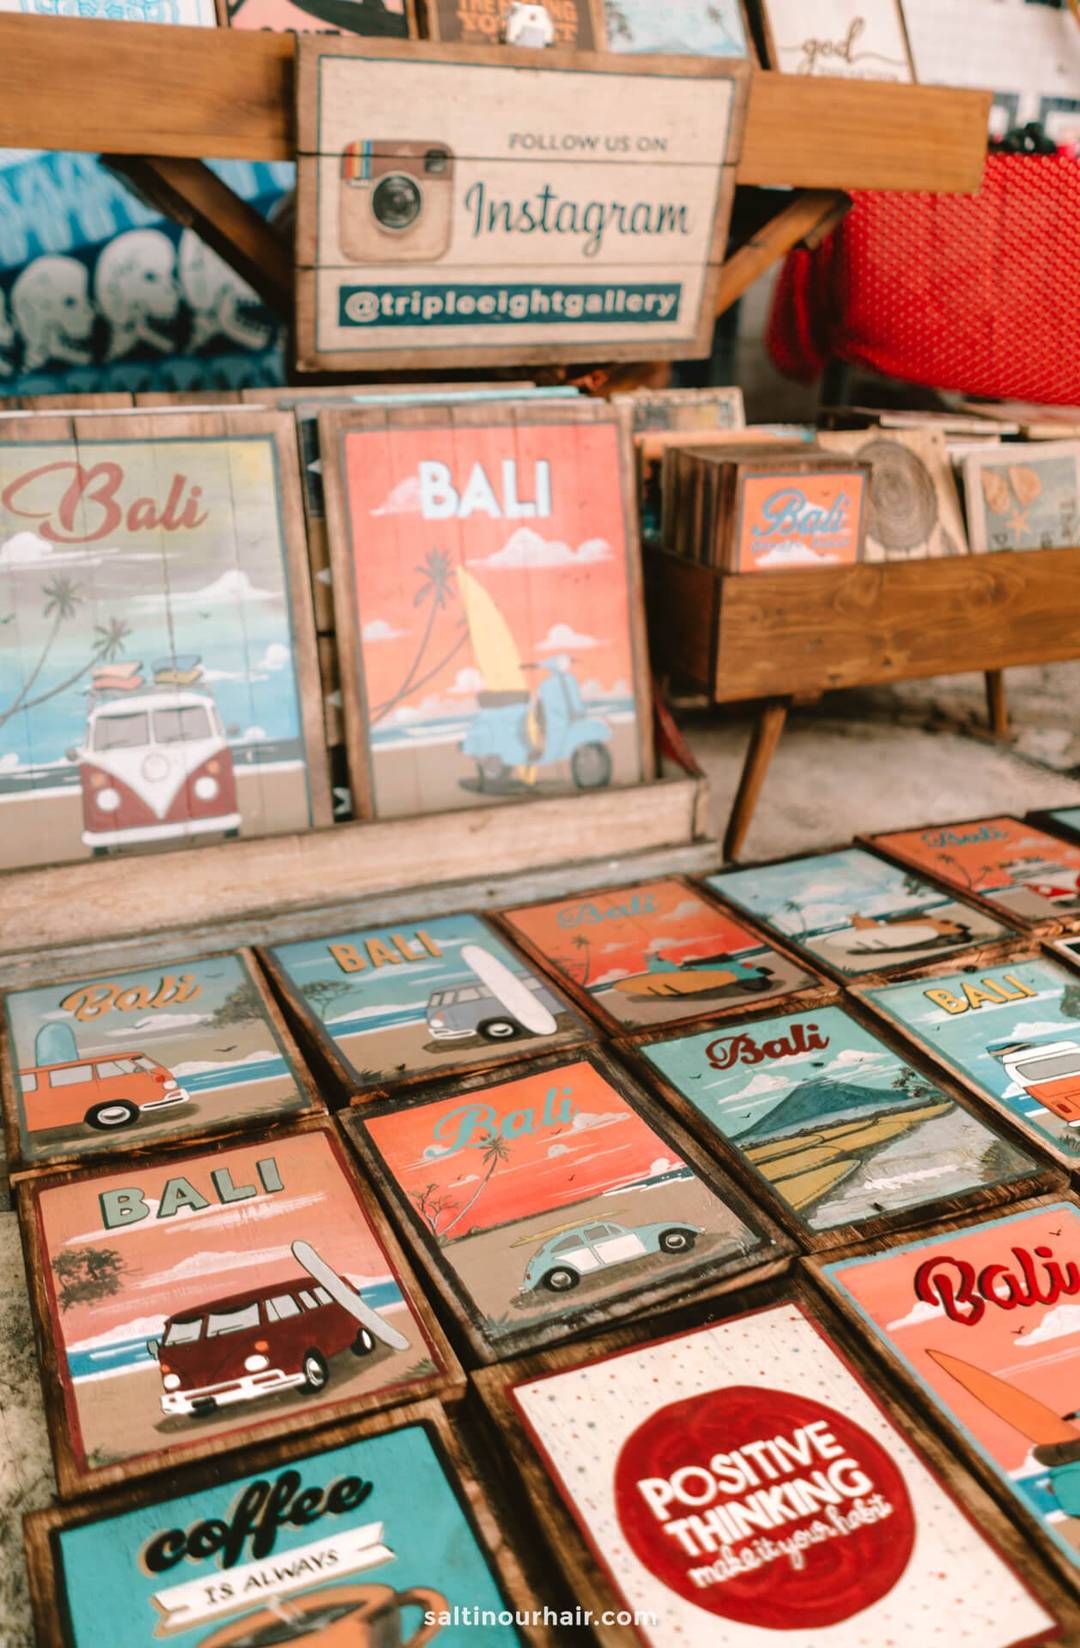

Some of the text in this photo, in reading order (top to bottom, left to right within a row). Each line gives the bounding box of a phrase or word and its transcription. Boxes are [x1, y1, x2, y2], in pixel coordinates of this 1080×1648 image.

[508, 132, 668, 153] FOLLOW US ON
[464, 181, 690, 257] Instagram
[345, 288, 677, 322] @tripleeightgallery
[1, 461, 209, 544] Bali
[418, 459, 551, 521] BALI
[751, 487, 852, 537] Bali
[556, 892, 657, 929] Bali
[327, 929, 443, 974] BALI
[59, 975, 203, 1022] Bali
[923, 975, 1039, 1016] BALI
[705, 1024, 830, 1070] Bali
[422, 1087, 581, 1159] Bali
[98, 1156, 285, 1230] BALI
[914, 1246, 1080, 1326] Bali
[637, 1420, 844, 1522] POSITIVE
[145, 1470, 374, 1572] coffee
[664, 1458, 873, 1557] THINKING
[687, 1494, 893, 1588] make it your habit
[204, 1548, 341, 1606] IS ALWAYS
